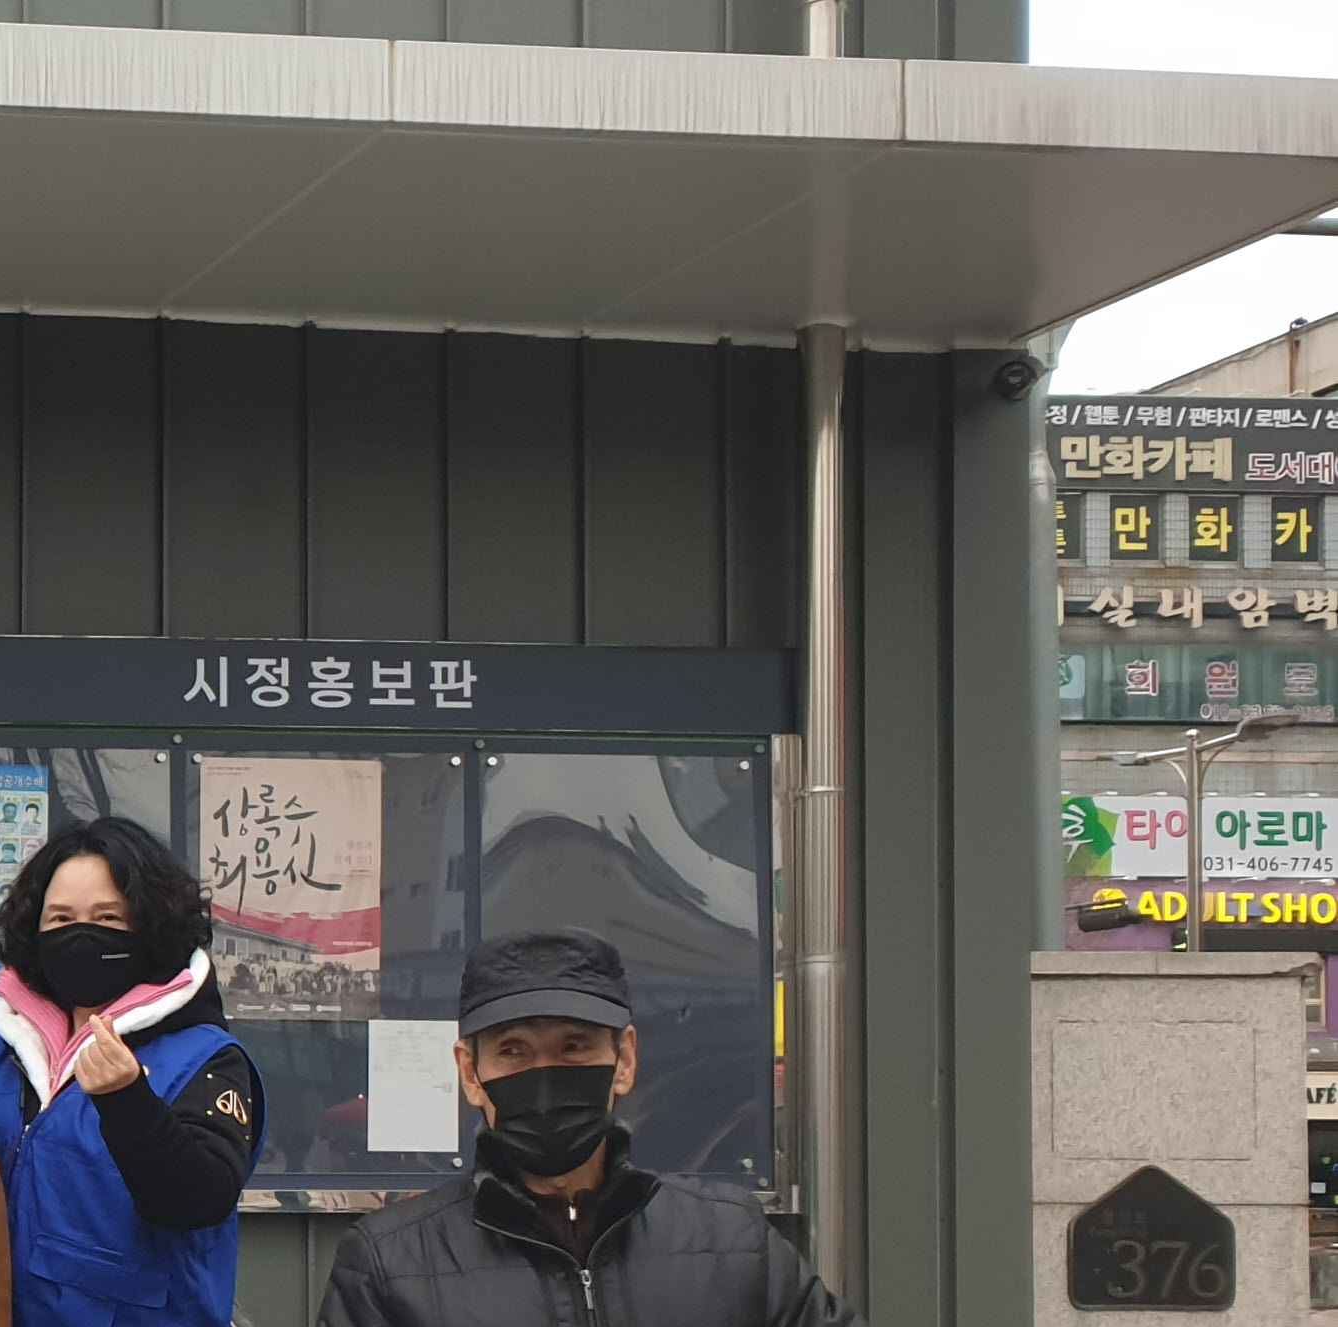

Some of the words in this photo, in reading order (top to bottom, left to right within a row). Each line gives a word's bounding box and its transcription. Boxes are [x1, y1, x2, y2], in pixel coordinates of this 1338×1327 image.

[1084, 405, 1121, 425] 웹툰
[1136, 407, 1173, 427] 무협
[1189, 408, 1240, 427] 판타지
[1255, 409, 1309, 429] 로맨스
[1060, 435, 1233, 481] 만화카페
[1245, 451, 1338, 484] 도서대
[183, 656, 478, 709] 시정홍보판
[213, 784, 319, 848] 상록수
[1216, 810, 1328, 851] 아로마
[1204, 857, 1334, 872] 031-406-7745
[1107, 1239, 1226, 1299] 376
